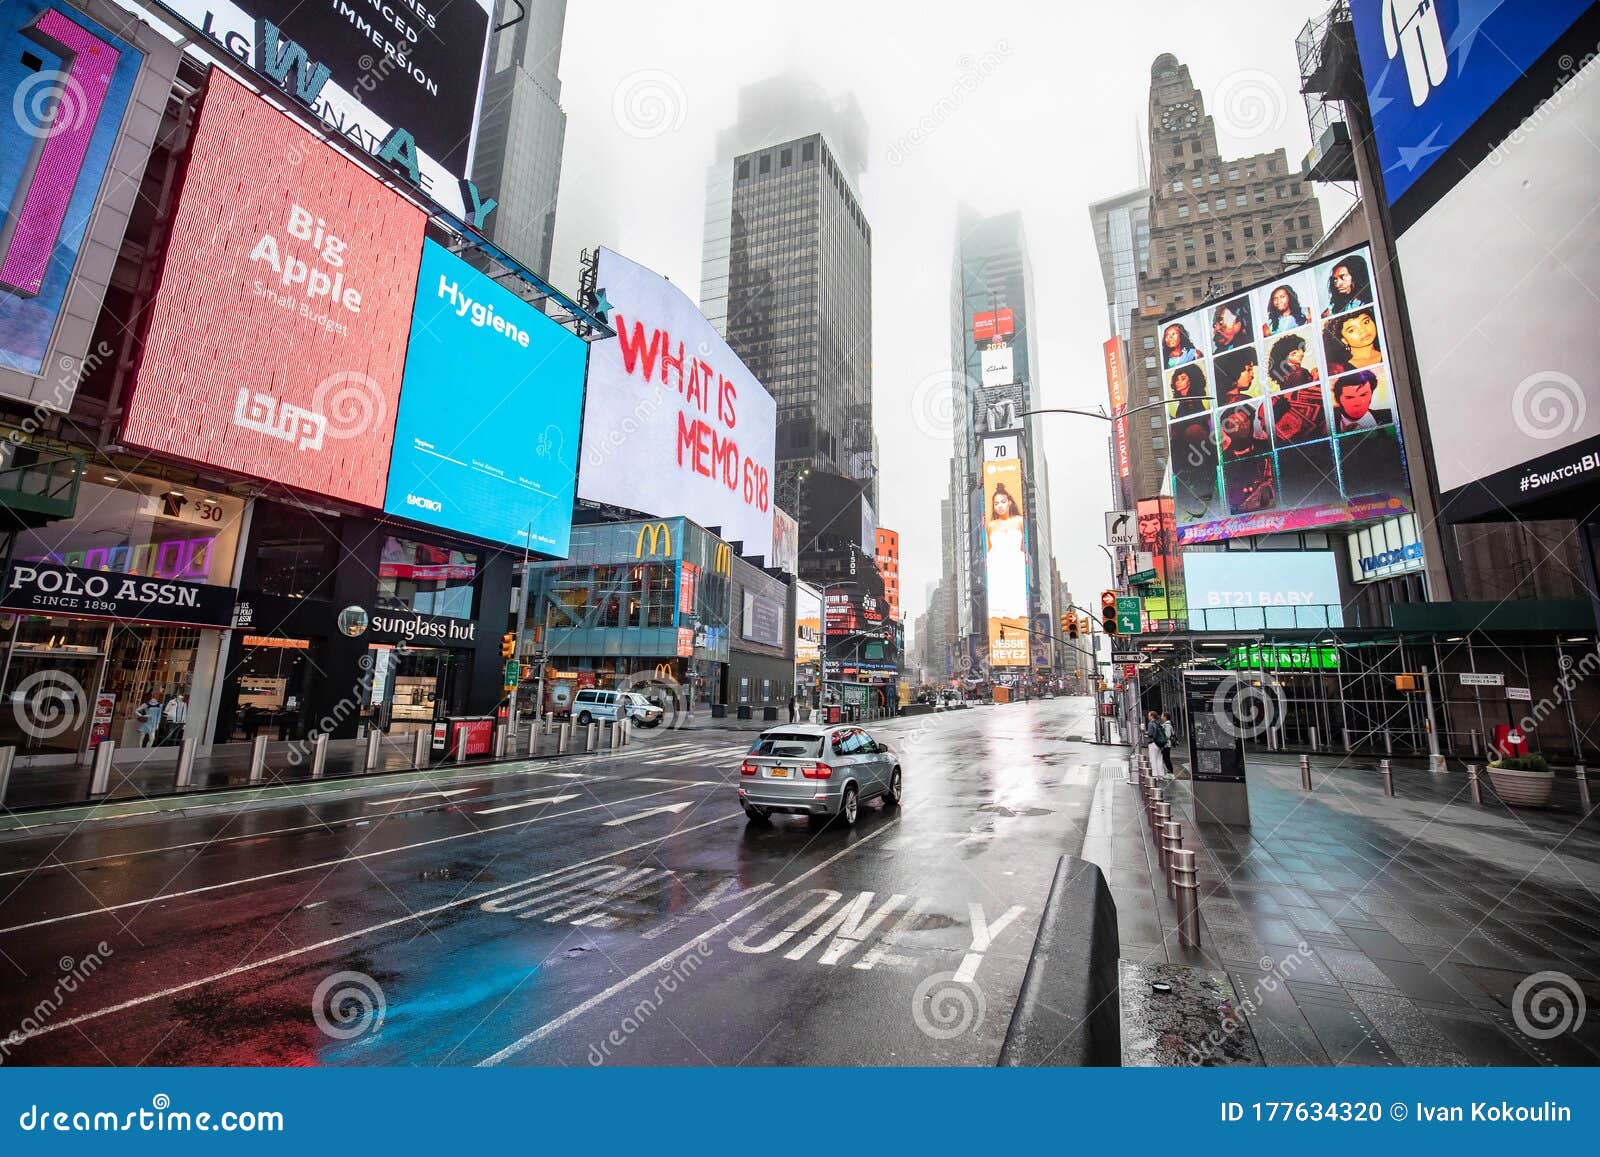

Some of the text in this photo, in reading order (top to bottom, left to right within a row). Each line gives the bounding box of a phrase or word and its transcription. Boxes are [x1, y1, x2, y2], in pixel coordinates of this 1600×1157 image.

[334, 0, 438, 97] IMMERSION
[287, 204, 348, 268] Big
[249, 234, 362, 313] Apple
[252, 280, 348, 339] Small Budget
[436, 273, 532, 350] Hygiene
[615, 313, 737, 429] WHAT IS
[677, 410, 769, 513] MEMO 618
[994, 445, 1007, 457] 70
[195, 501, 223, 522] $30
[1111, 535, 1133, 543] ONLY
[1184, 523, 1223, 539] Black
[1358, 541, 1423, 572] VIACOMCB
[9, 566, 202, 607] POLO ASSN.
[1207, 590, 1315, 606] BT21 BABY
[32, 595, 117, 611] SINCE 1890
[372, 615, 476, 641] sunglass hut
[991, 639, 1027, 649] JESSIE
[992, 649, 1027, 660] REYEZ
